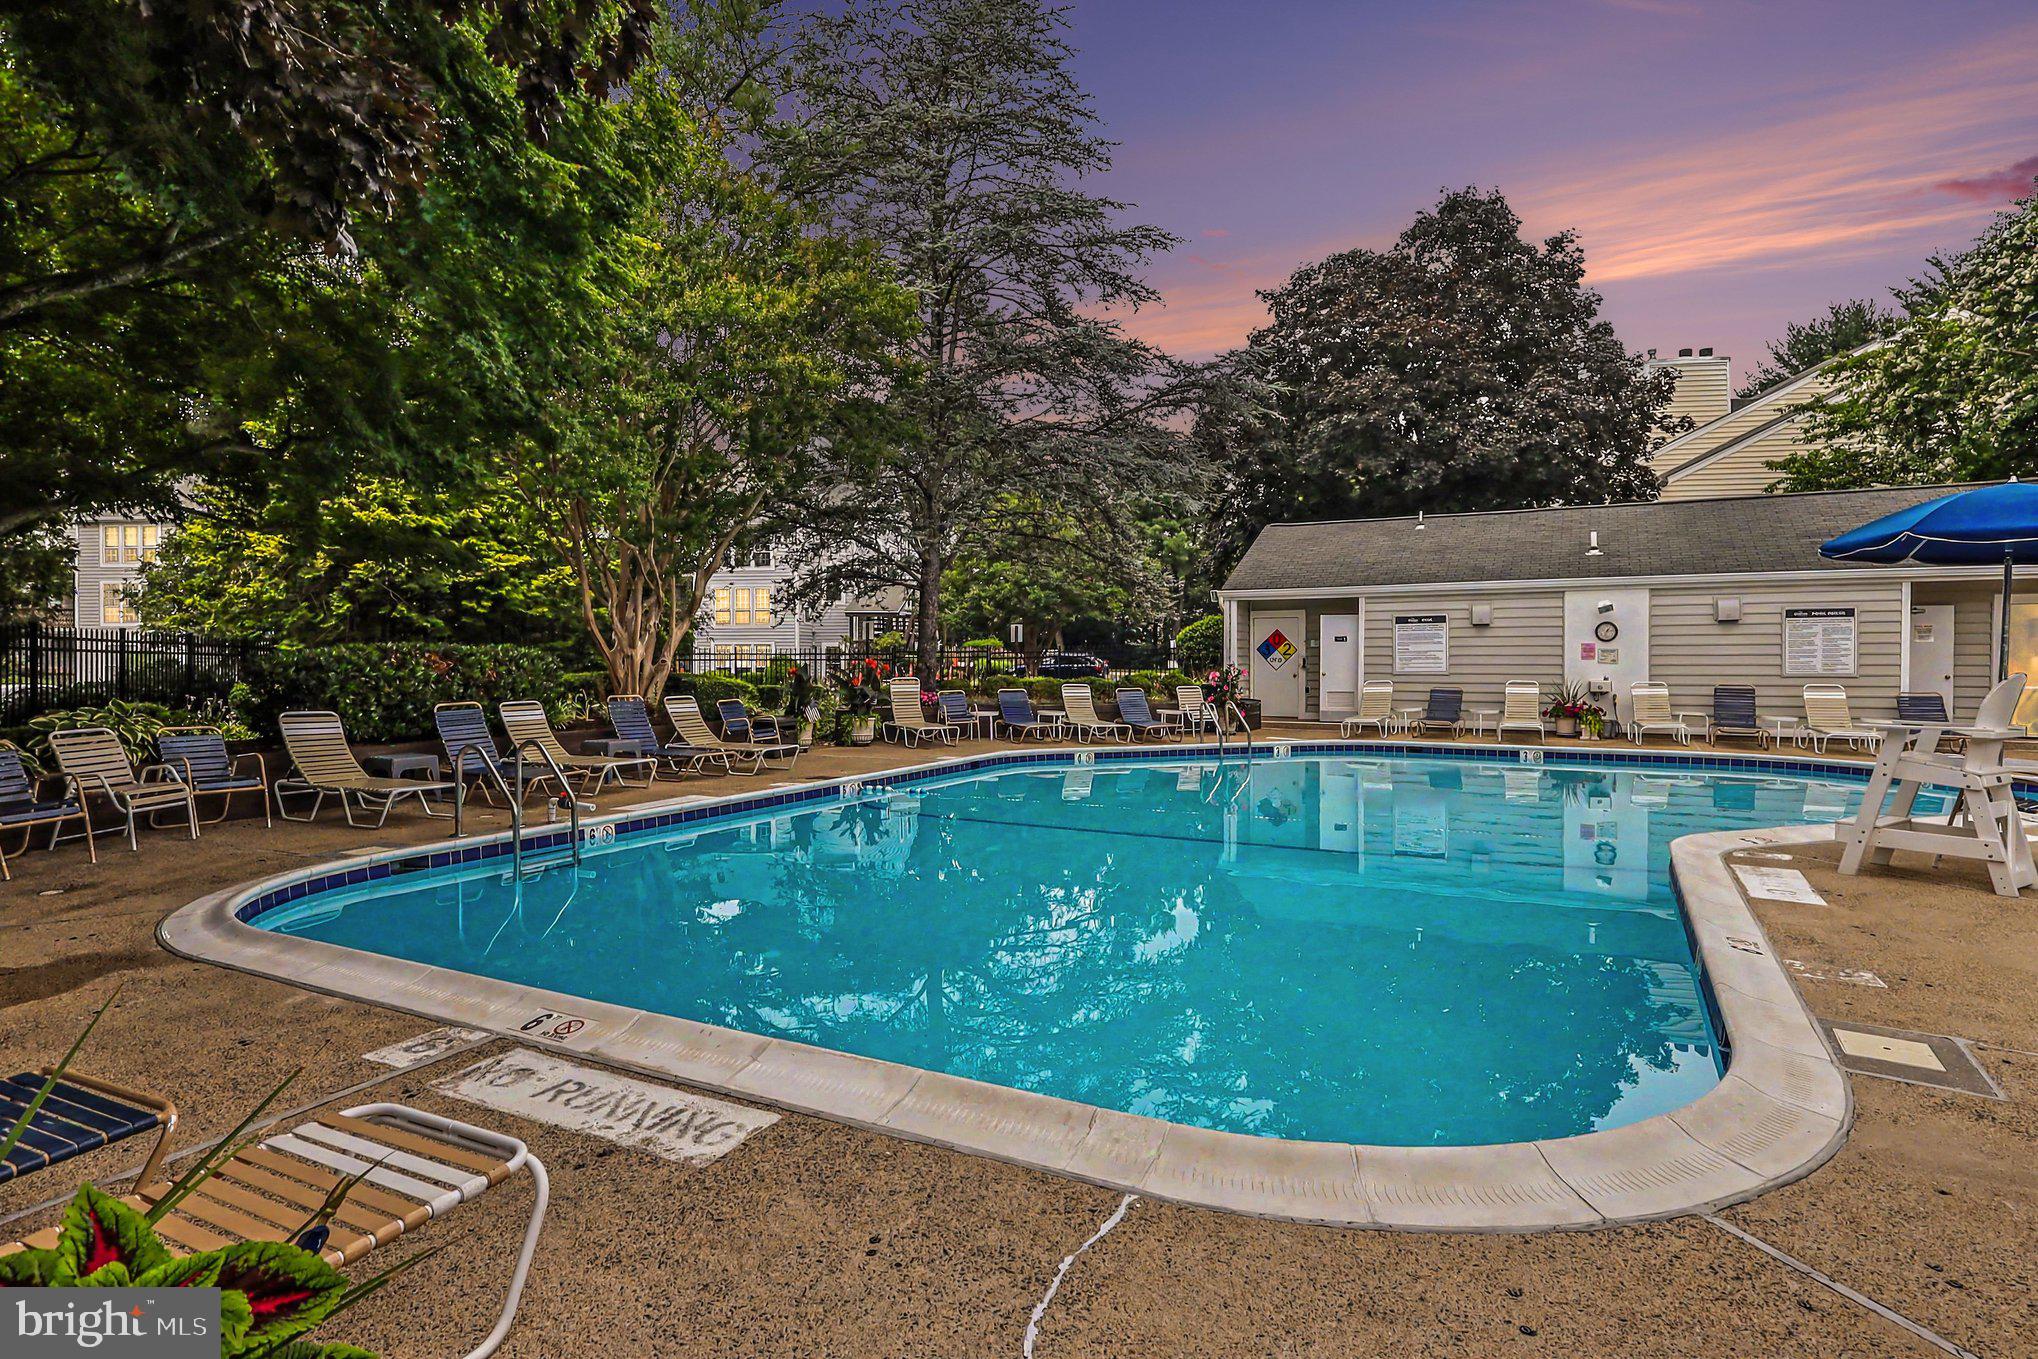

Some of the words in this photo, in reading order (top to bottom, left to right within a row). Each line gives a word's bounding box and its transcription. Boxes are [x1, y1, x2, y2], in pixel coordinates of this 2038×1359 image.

[1283, 643, 1292, 656] 2
[520, 1013, 553, 1030] 6
[530, 1078, 737, 1144] RUNNING
